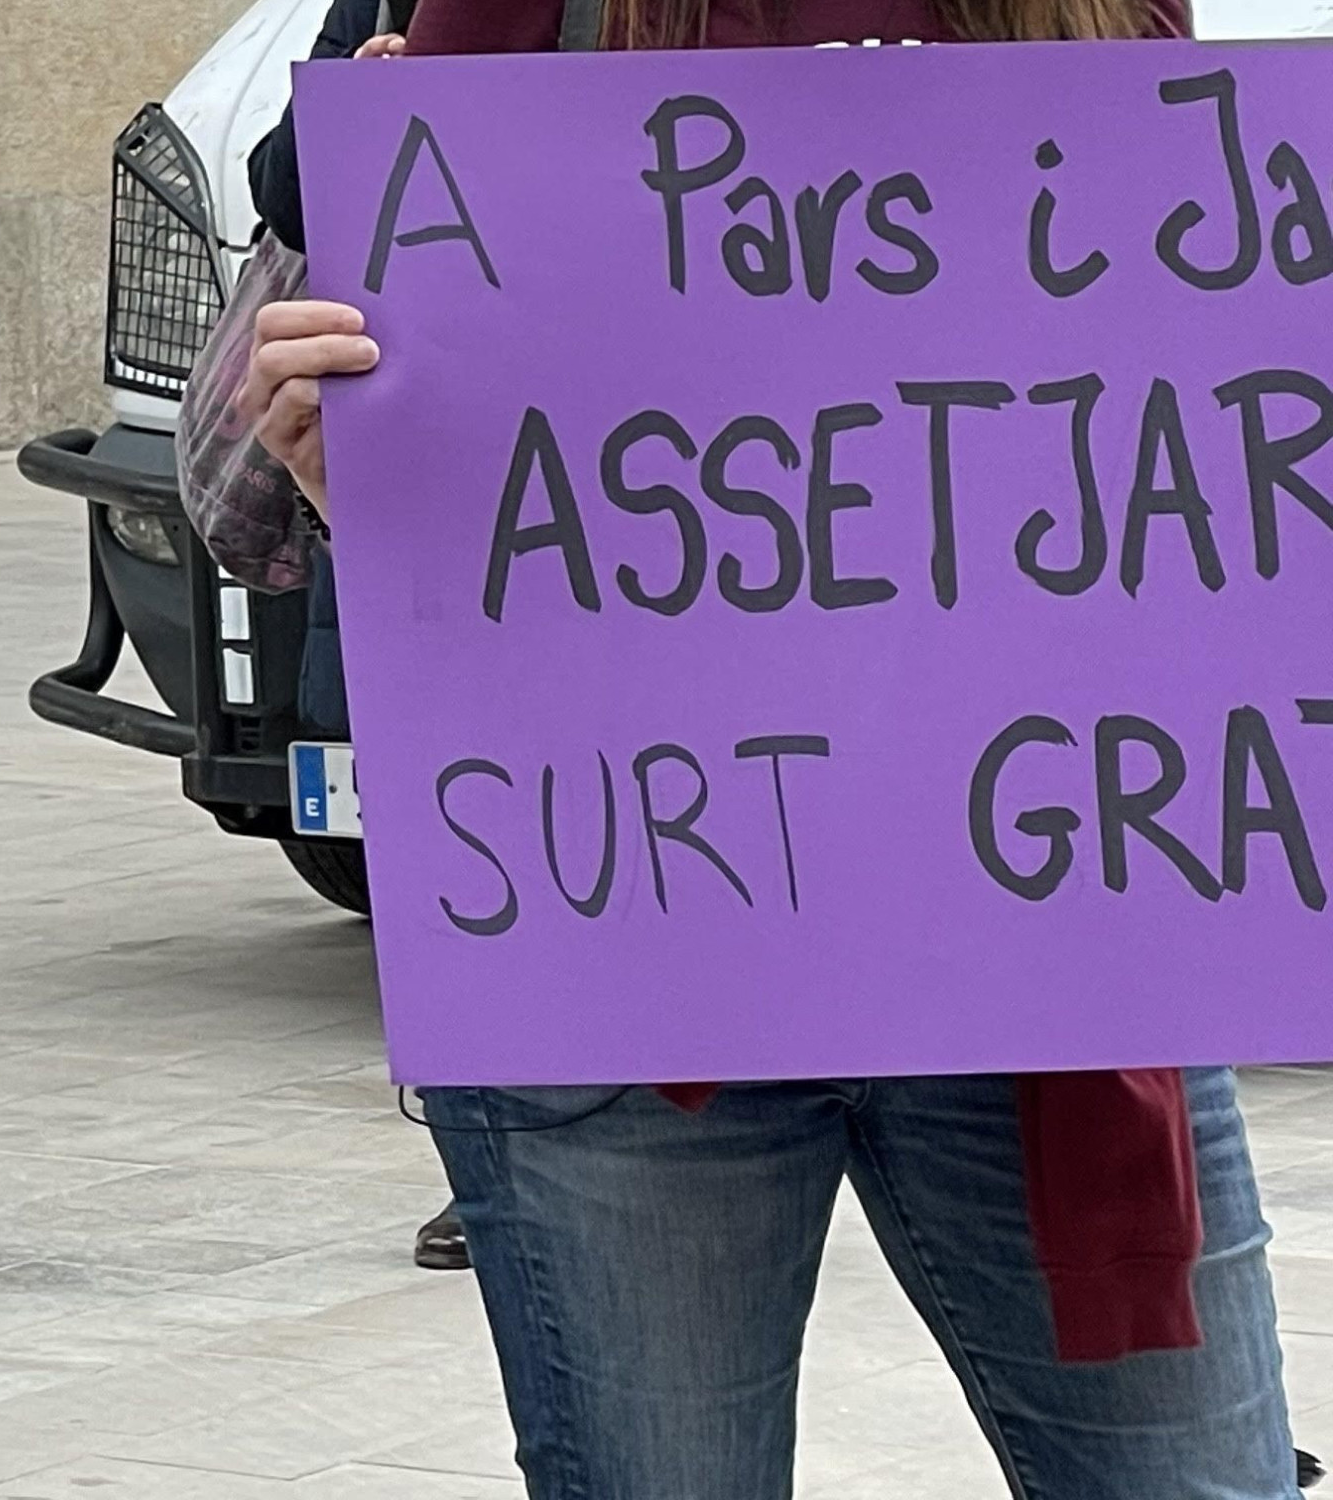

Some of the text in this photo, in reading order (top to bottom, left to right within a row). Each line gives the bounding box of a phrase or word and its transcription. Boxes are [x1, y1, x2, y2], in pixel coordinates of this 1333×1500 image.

[364, 69, 1333, 302] A Pars i Ja
[483, 369, 1333, 624] ASSETJAR
[305, 797, 320, 817] E
[437, 699, 1333, 936] SURT GRA
